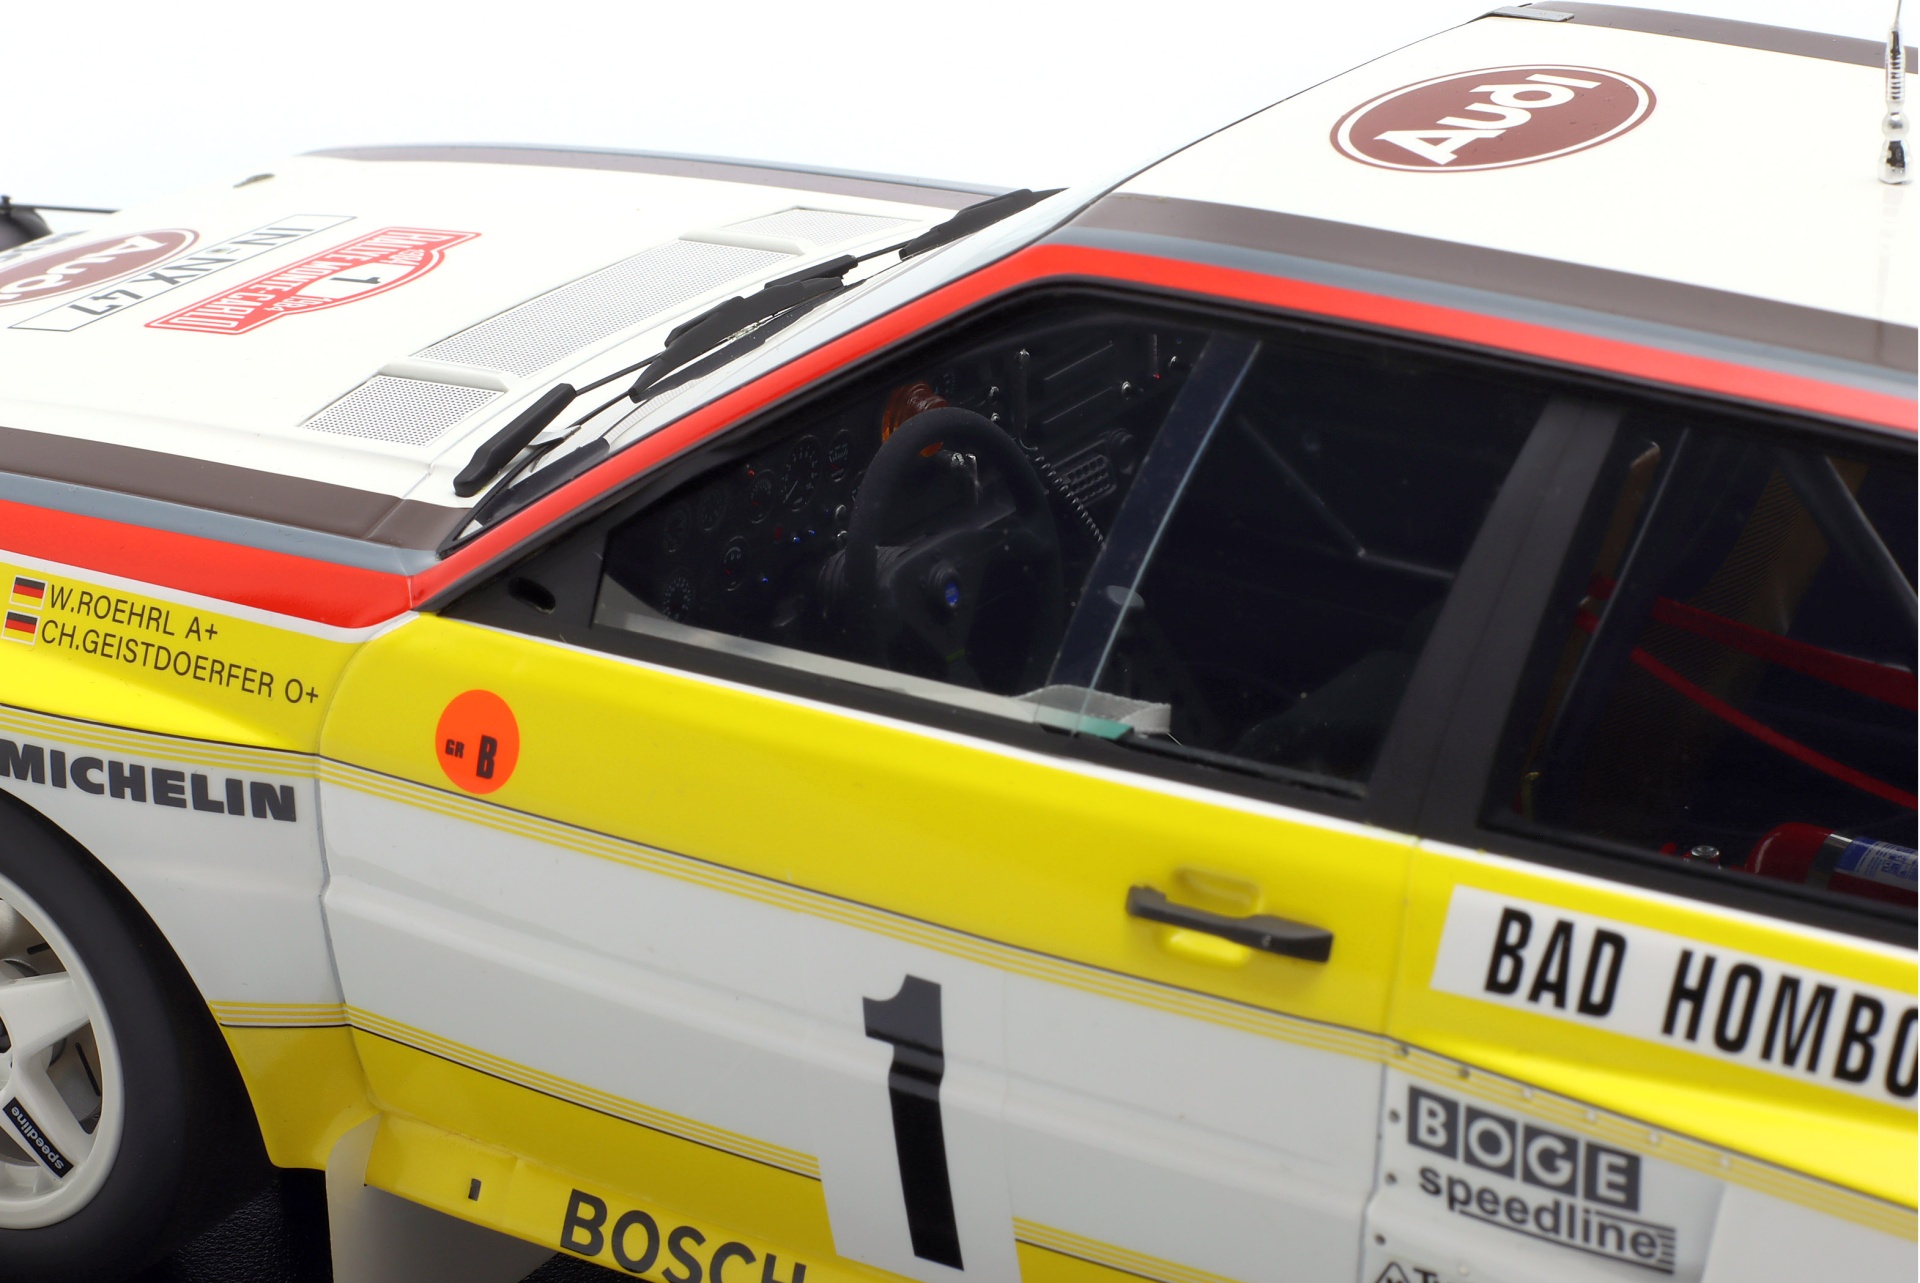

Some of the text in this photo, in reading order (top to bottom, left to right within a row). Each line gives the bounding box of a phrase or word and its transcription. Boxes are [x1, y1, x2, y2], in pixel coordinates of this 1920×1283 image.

[1373, 74, 1602, 166] Audi
[68, 289, 143, 315] 47
[169, 231, 456, 328] RALLYE MONTE-CARLO
[264, 296, 333, 311] 1984
[329, 276, 381, 284] 1
[50, 584, 218, 641] W.ROEHRL A+
[41, 620, 274, 698] CH.GEISTDOERFER
[0, 738, 297, 822] MICHELIN
[445, 738, 465, 759] GR
[476, 734, 498, 780] B
[1484, 907, 1917, 1098] BAD HOMBO
[11, 1106, 65, 1169] speedline
[862, 973, 965, 1272] 1
[1414, 1092, 1631, 1204] BOGE
[1418, 1165, 1659, 1261] speedline
